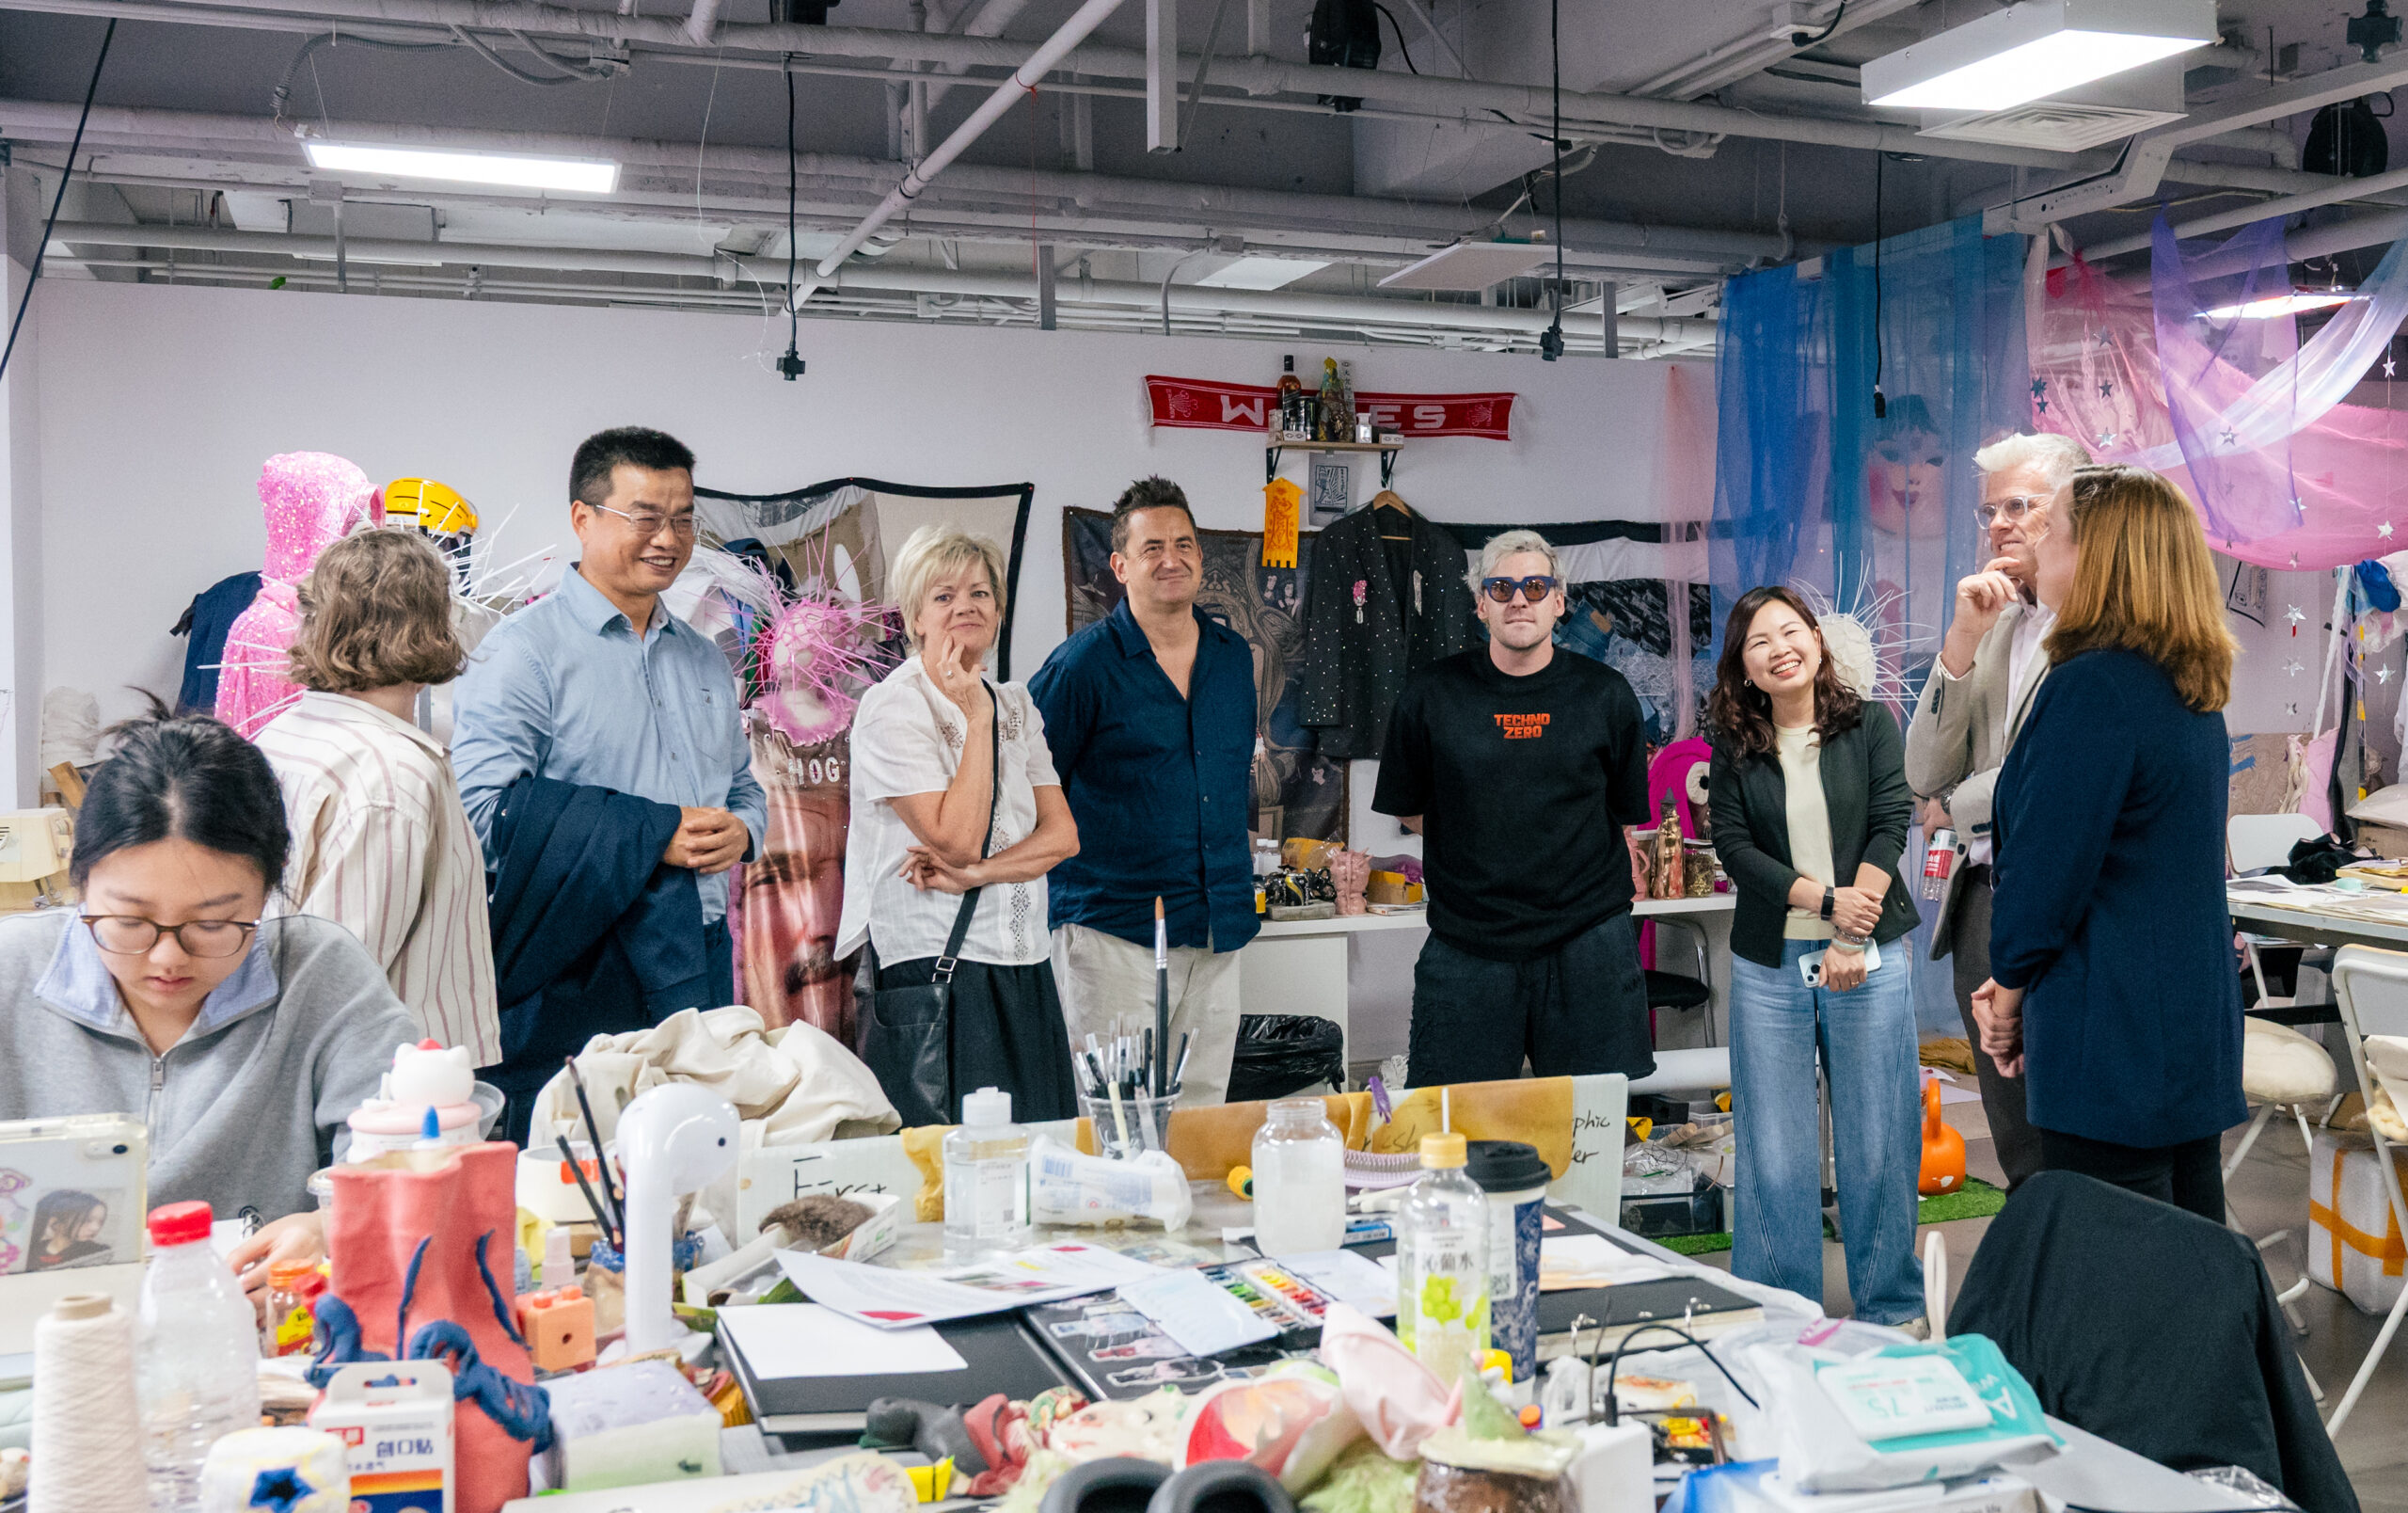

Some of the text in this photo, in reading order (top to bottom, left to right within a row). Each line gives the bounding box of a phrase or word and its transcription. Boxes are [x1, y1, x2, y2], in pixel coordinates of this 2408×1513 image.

[1494, 712, 1551, 726] TECHNO
[1503, 725, 1543, 740] ZERO
[787, 756, 841, 786] HOG
